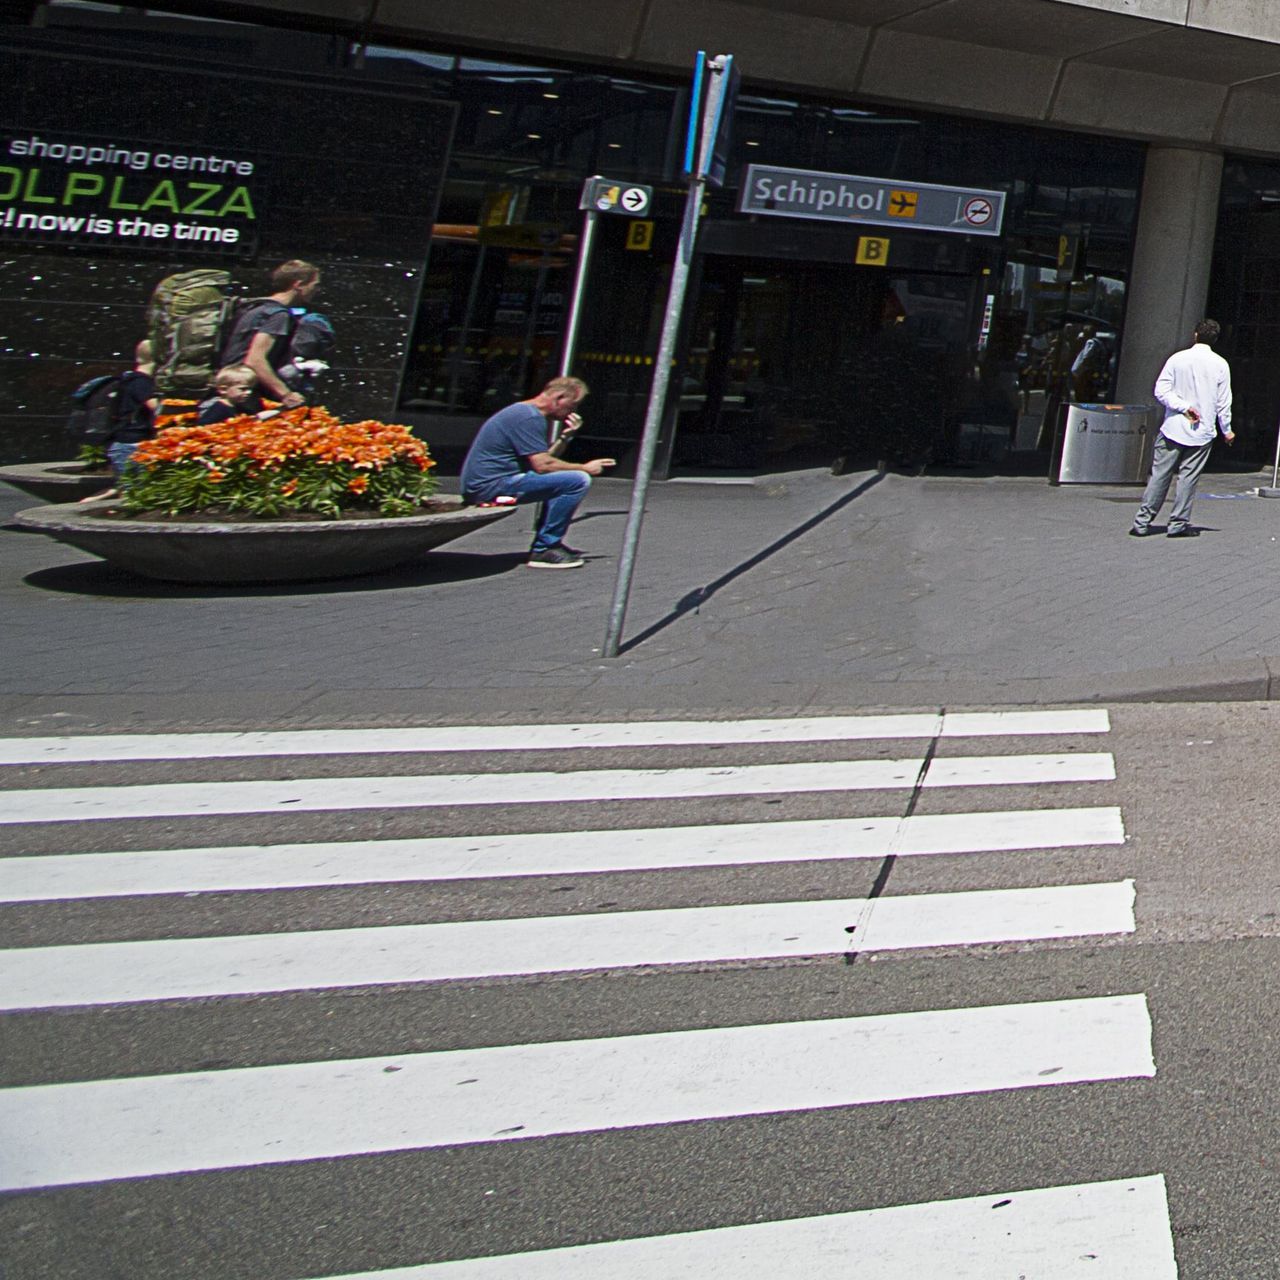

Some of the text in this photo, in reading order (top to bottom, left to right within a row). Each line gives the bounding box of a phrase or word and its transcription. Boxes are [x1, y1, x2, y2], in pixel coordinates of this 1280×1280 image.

[9, 137, 254, 176] shopping centre
[754, 177, 885, 211] Schiphol
[17, 212, 86, 233] now
[86, 213, 114, 236] is
[117, 217, 171, 240] the
[174, 221, 240, 244] time
[631, 223, 647, 246] B
[864, 238, 883, 261] B
